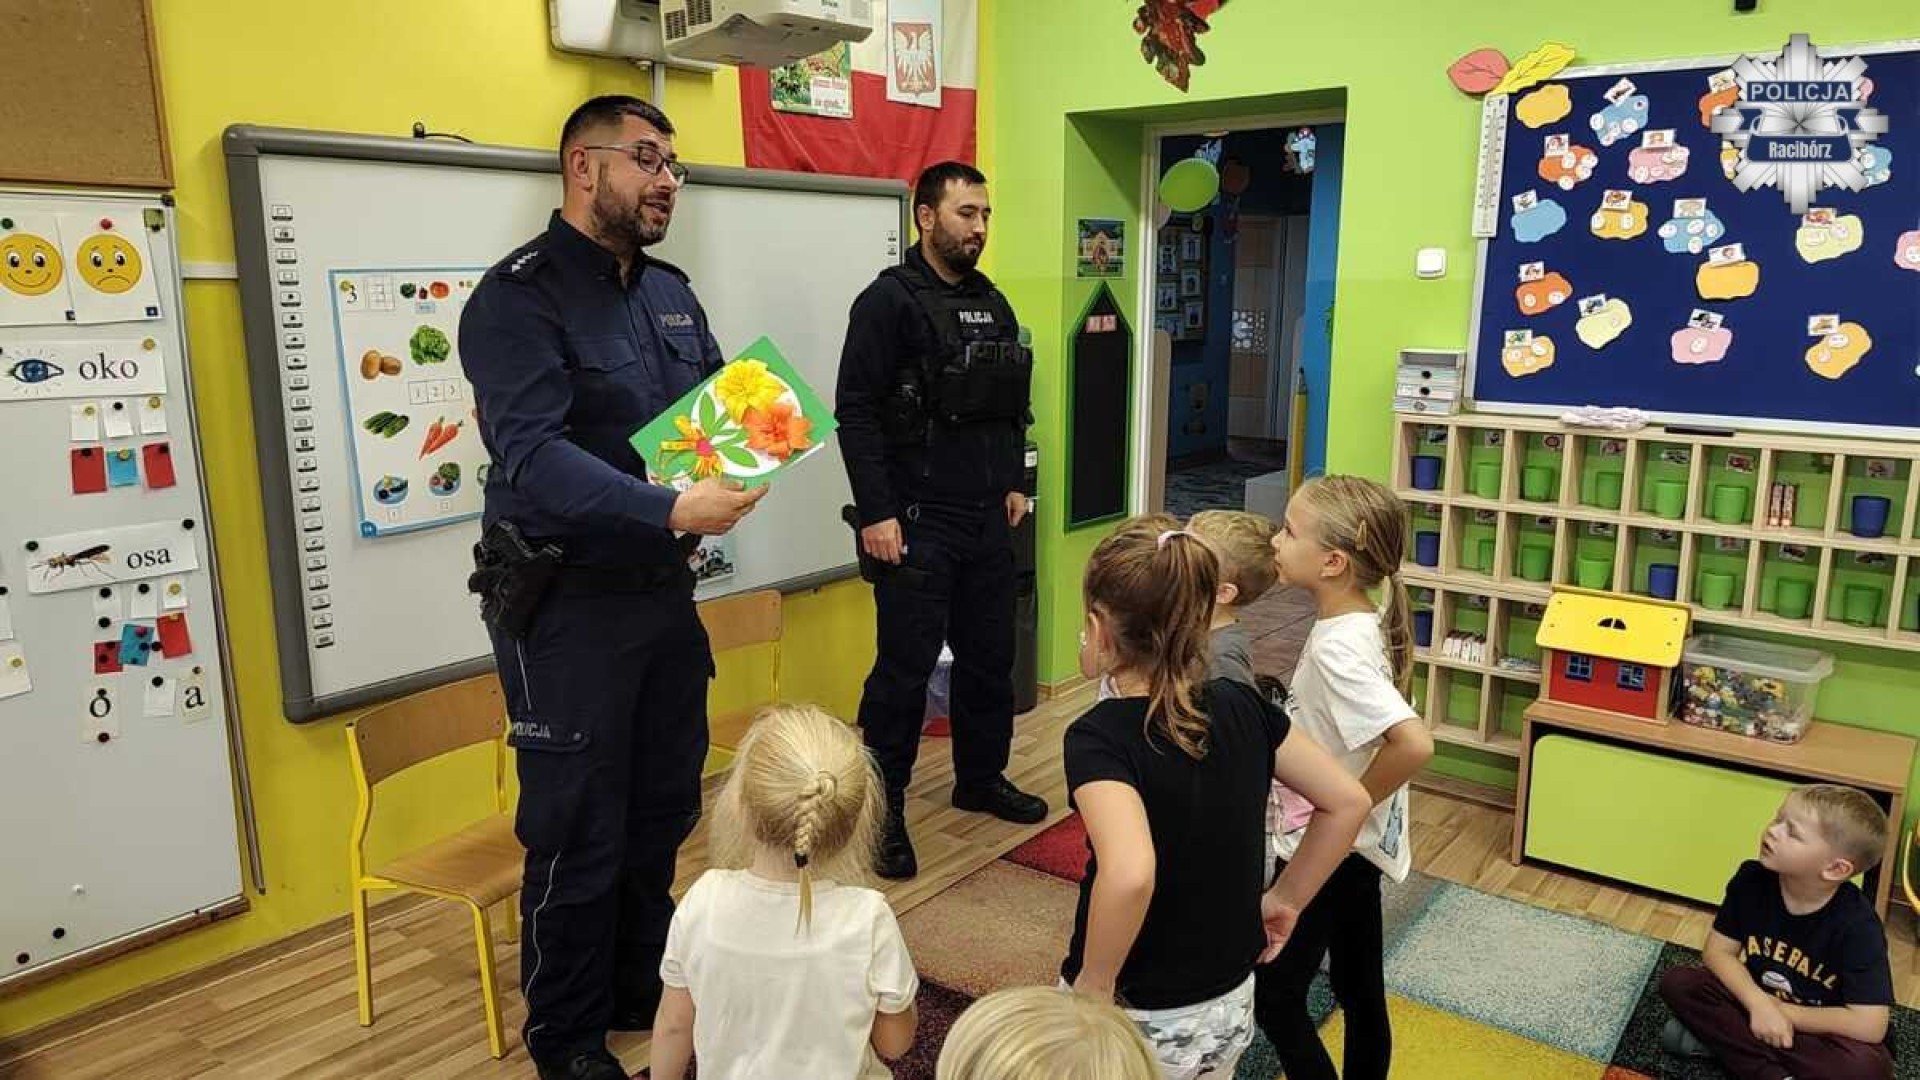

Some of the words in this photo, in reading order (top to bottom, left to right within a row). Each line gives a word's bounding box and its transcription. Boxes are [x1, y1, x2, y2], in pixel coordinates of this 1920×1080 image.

[958, 311, 994, 323] POLICJA
[79, 353, 138, 381] oko
[127, 547, 171, 570] osa
[184, 685, 205, 709] a
